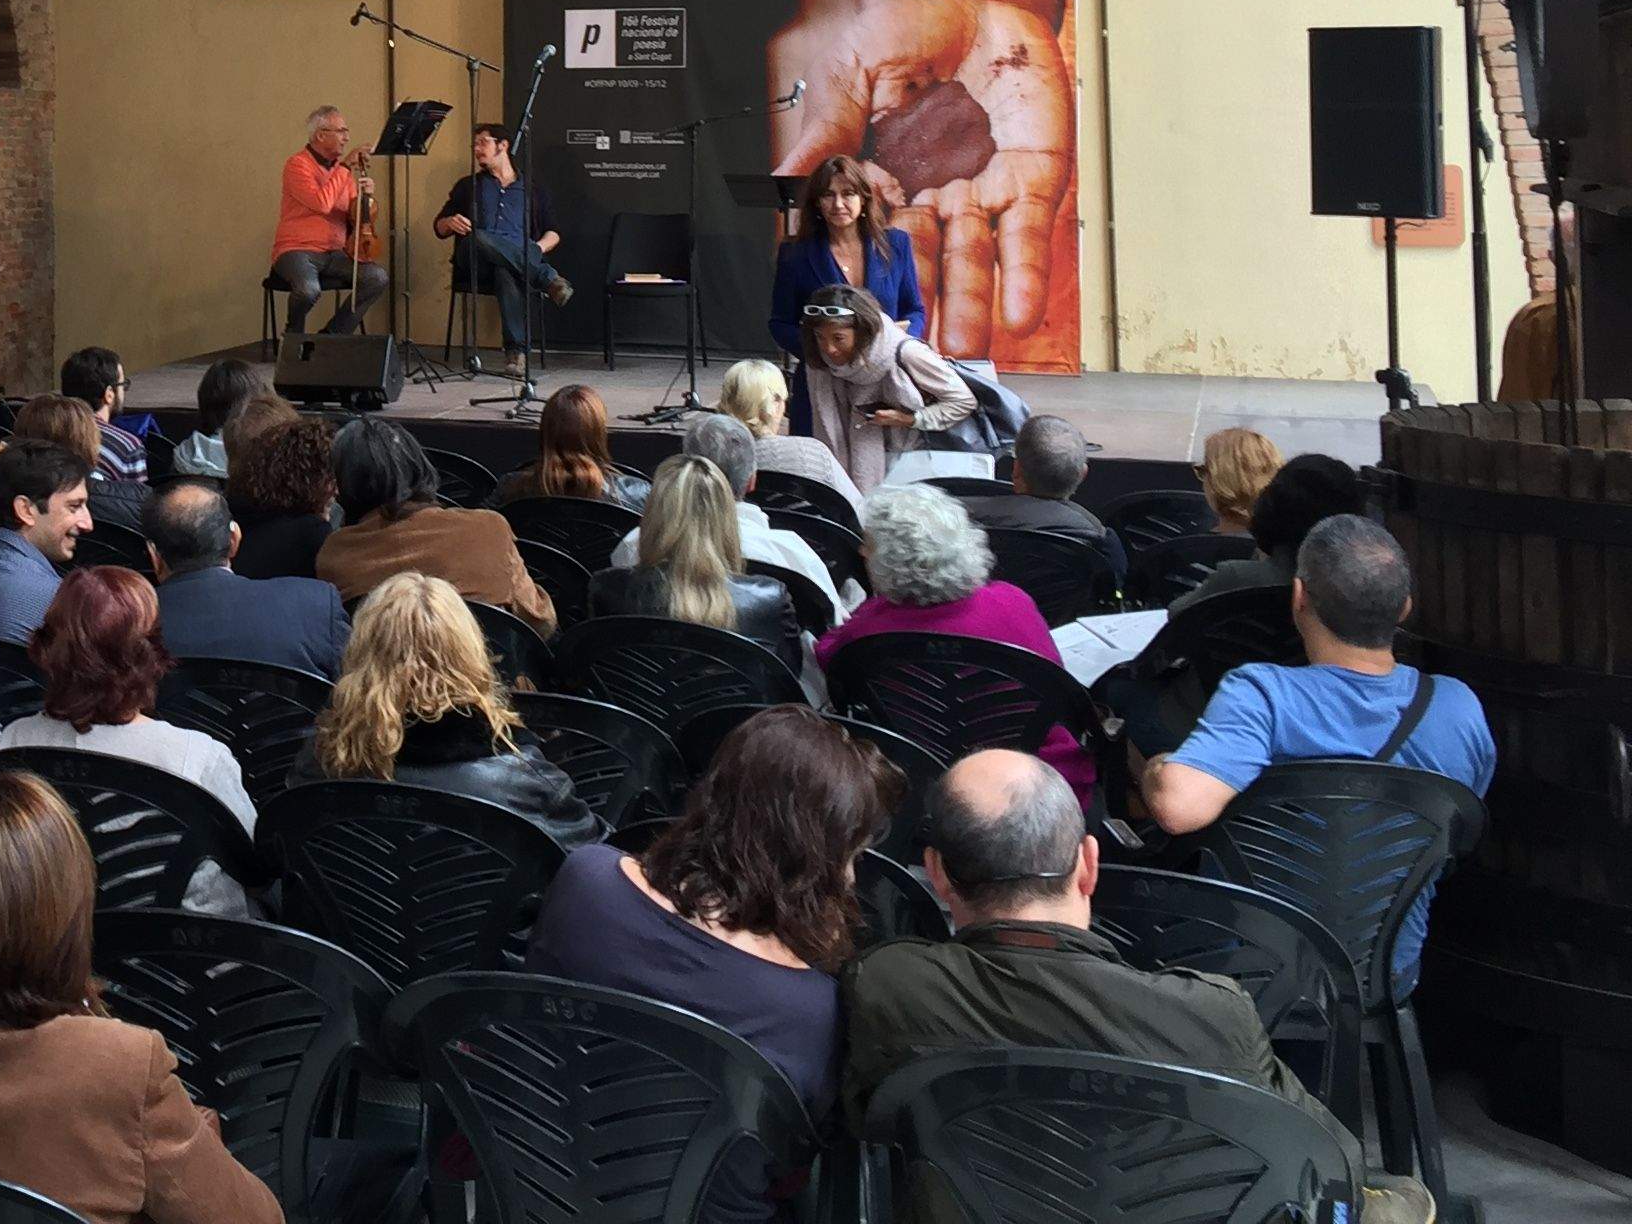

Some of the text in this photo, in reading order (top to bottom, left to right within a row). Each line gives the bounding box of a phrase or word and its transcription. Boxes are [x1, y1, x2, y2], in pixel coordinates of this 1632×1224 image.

[640, 15, 679, 26] Festival
[621, 27, 679, 37] nacional de
[581, 23, 601, 53] p
[632, 39, 667, 51] poesia
[651, 51, 673, 62] Cugat
